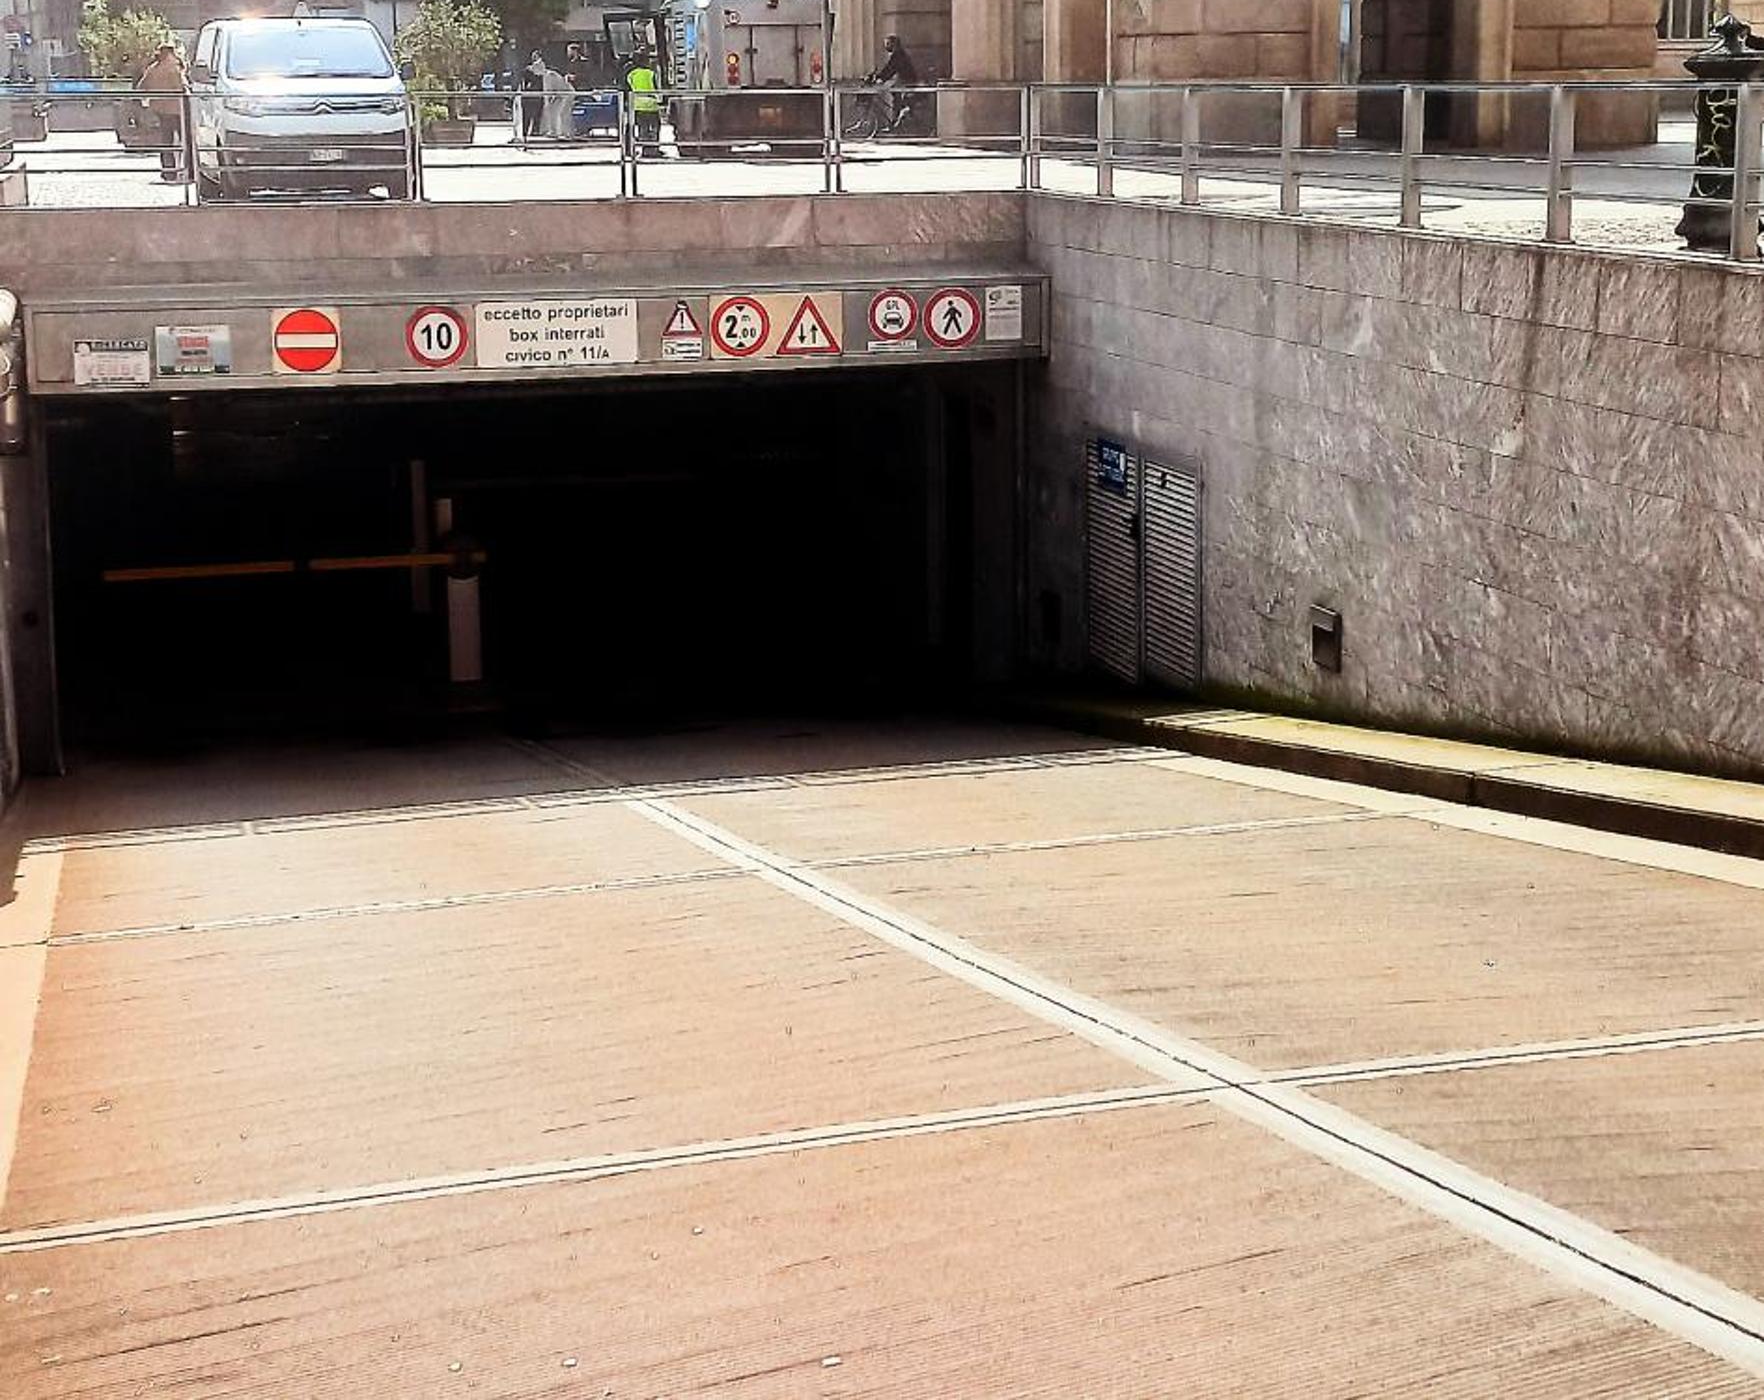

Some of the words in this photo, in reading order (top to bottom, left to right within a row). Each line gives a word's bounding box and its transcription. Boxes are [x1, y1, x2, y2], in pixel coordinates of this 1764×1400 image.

[484, 304, 541, 320] eccetto
[548, 303, 628, 321] proprietari
[421, 322, 452, 350] 10
[510, 328, 538, 342] box
[544, 325, 604, 340] interrati
[505, 349, 551, 362] civico
